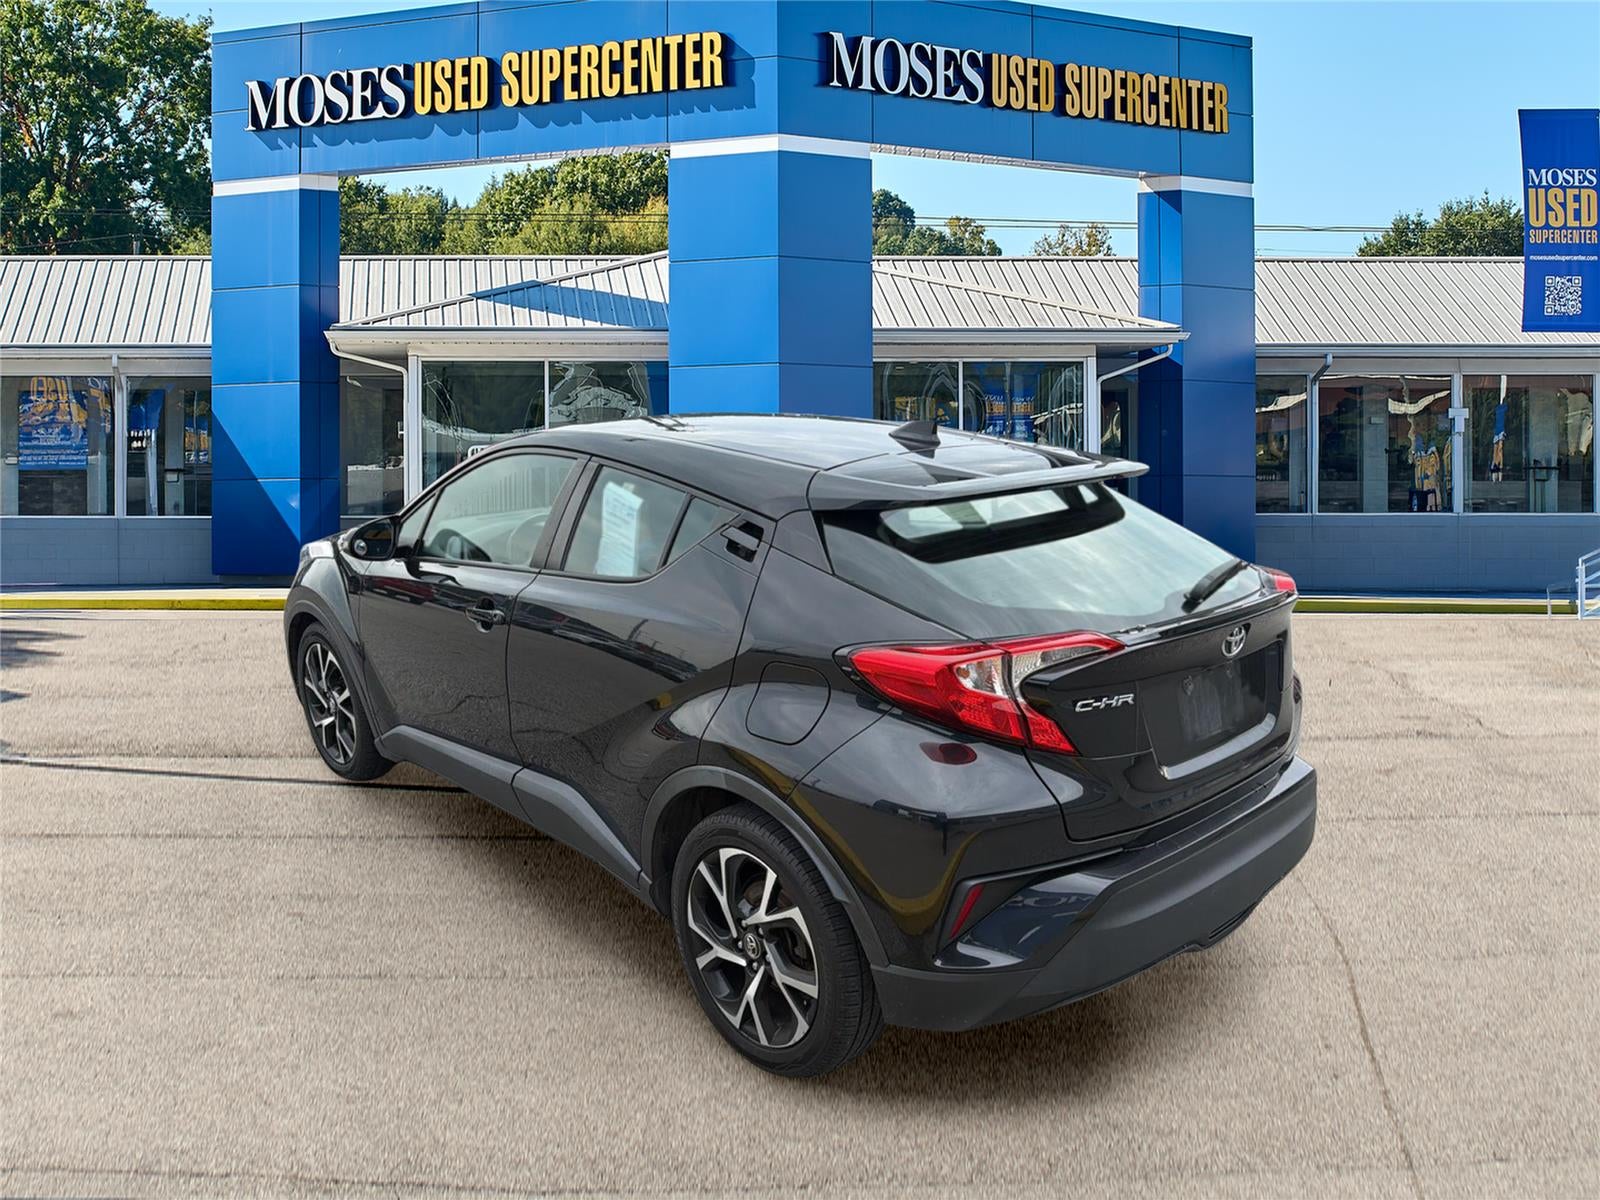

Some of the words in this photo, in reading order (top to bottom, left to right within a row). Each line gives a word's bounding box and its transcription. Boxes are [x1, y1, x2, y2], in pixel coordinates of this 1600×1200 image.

[244, 65, 405, 132] MOSES
[413, 56, 489, 116] USED
[501, 31, 724, 107] SUPERCENTER
[829, 31, 985, 105] MOSES
[991, 53, 1056, 112] USED
[1065, 63, 1230, 133] SUPERCENTER
[1528, 169, 1597, 186] MOSES
[1529, 188, 1598, 228] USED
[1530, 230, 1598, 244] SUPERCENTER
[1075, 694, 1134, 712] C-HR
